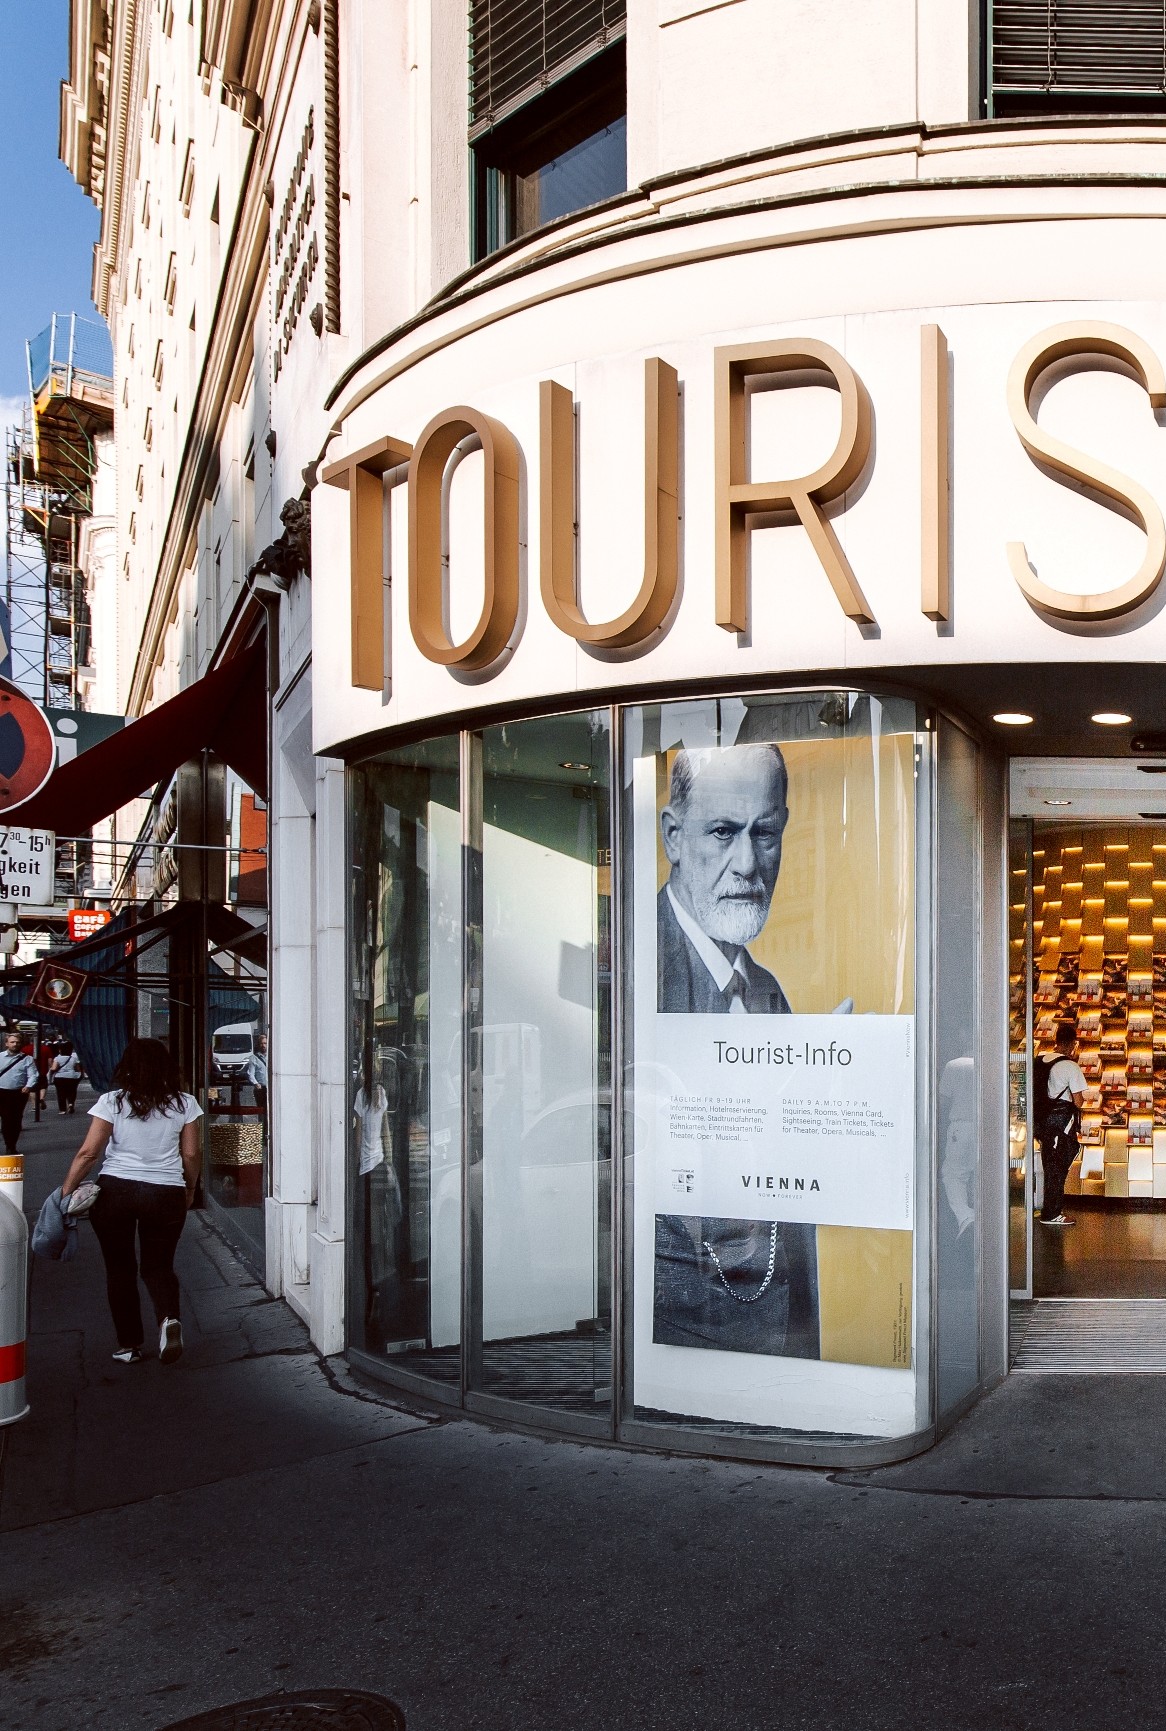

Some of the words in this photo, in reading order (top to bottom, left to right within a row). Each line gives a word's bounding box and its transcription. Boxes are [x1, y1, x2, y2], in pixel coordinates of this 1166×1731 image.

[713, 1041, 852, 1066] Tourist-Info
[841, 1109, 864, 1117] Vienna
[708, 1123, 753, 1133] Eintrittskarten
[754, 1125, 764, 1133] für
[825, 1118, 842, 1126] Train
[870, 1119, 895, 1128] Tickets
[782, 1126, 791, 1134] for
[741, 1175, 821, 1192] VIENNA
